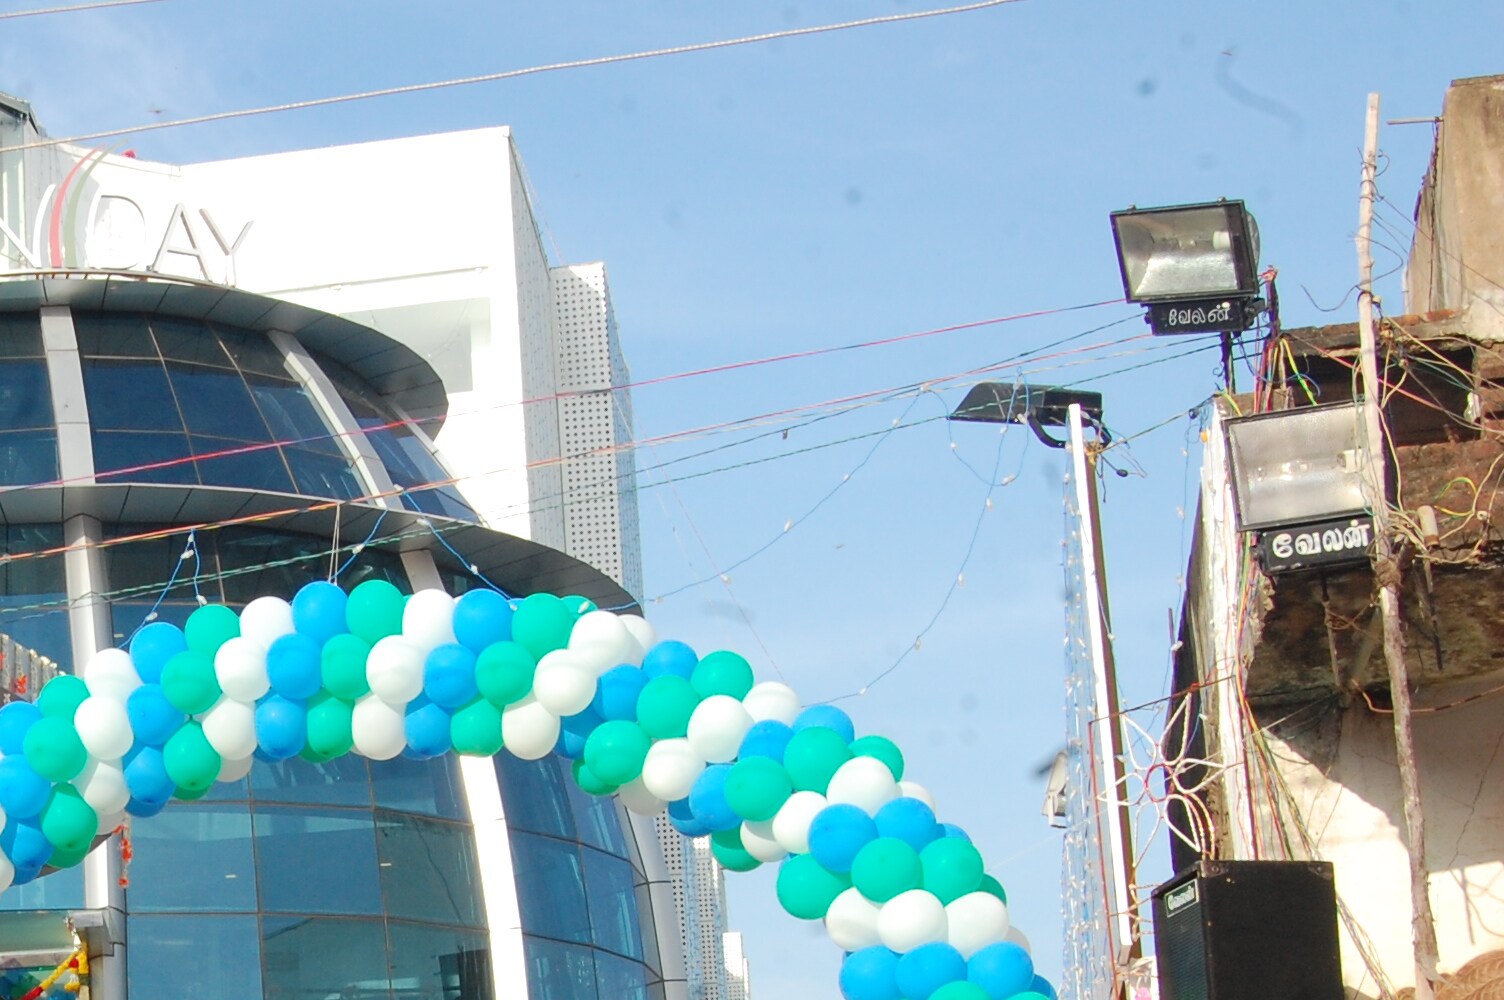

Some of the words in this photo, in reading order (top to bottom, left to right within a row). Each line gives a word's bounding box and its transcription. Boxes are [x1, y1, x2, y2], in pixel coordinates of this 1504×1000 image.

[84, 182, 254, 288] DAY
[1168, 301, 1231, 326] வேலன்
[1272, 518, 1371, 559] வேலன்
